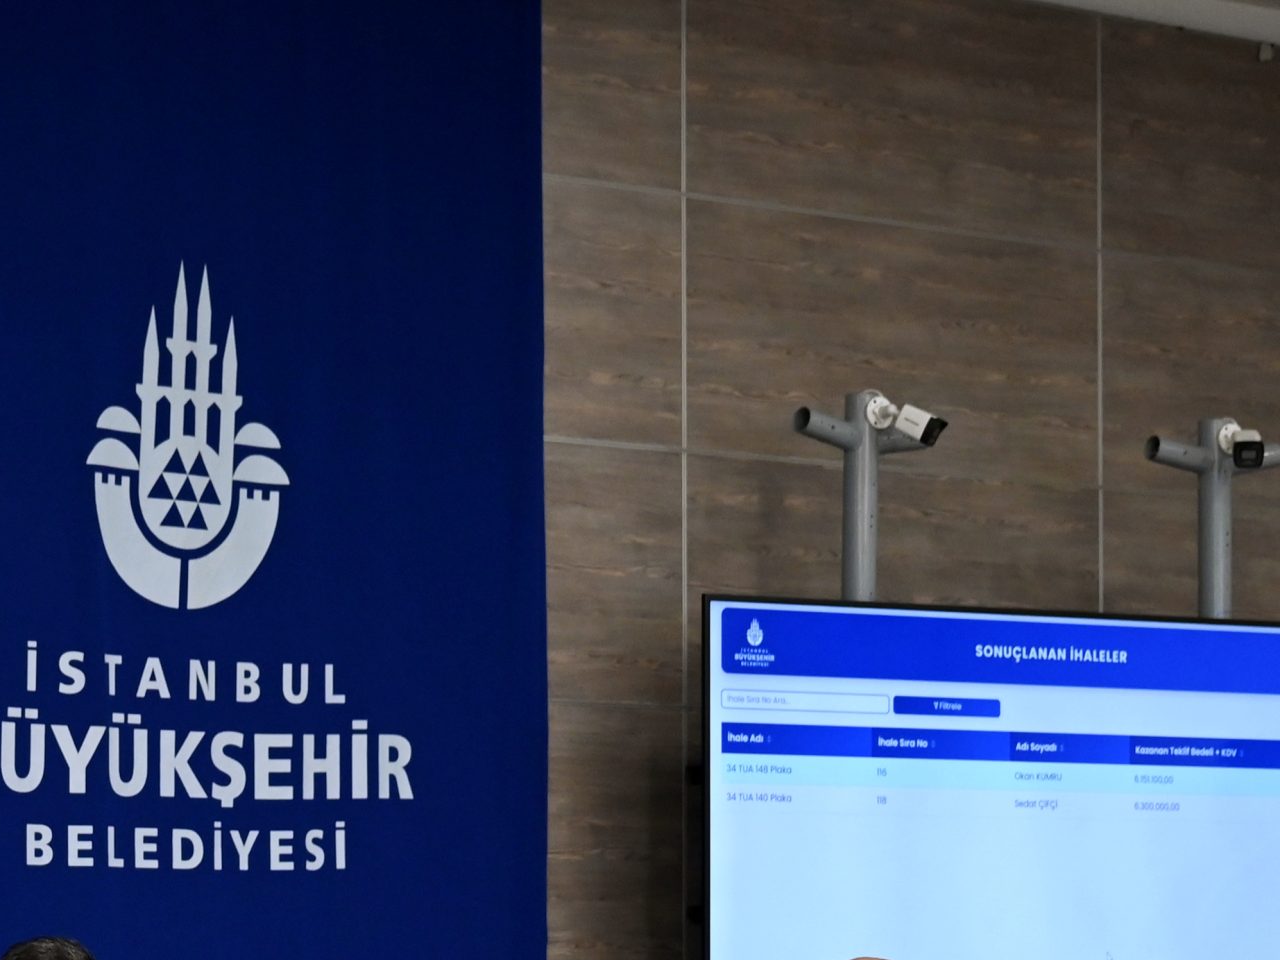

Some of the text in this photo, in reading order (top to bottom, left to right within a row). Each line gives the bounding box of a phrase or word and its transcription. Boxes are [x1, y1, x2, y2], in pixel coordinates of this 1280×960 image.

[975, 644, 1128, 664] SONUÇLANAN İHALELER
[26, 640, 346, 704] İSTANBUL
[727, 731, 764, 743] İhale Adı
[877, 736, 929, 748] İhale Sıra No
[1015, 742, 1029, 751] Adı
[1135, 745, 1169, 756] Kazanan
[25, 820, 346, 871] BELEDİYESİ
